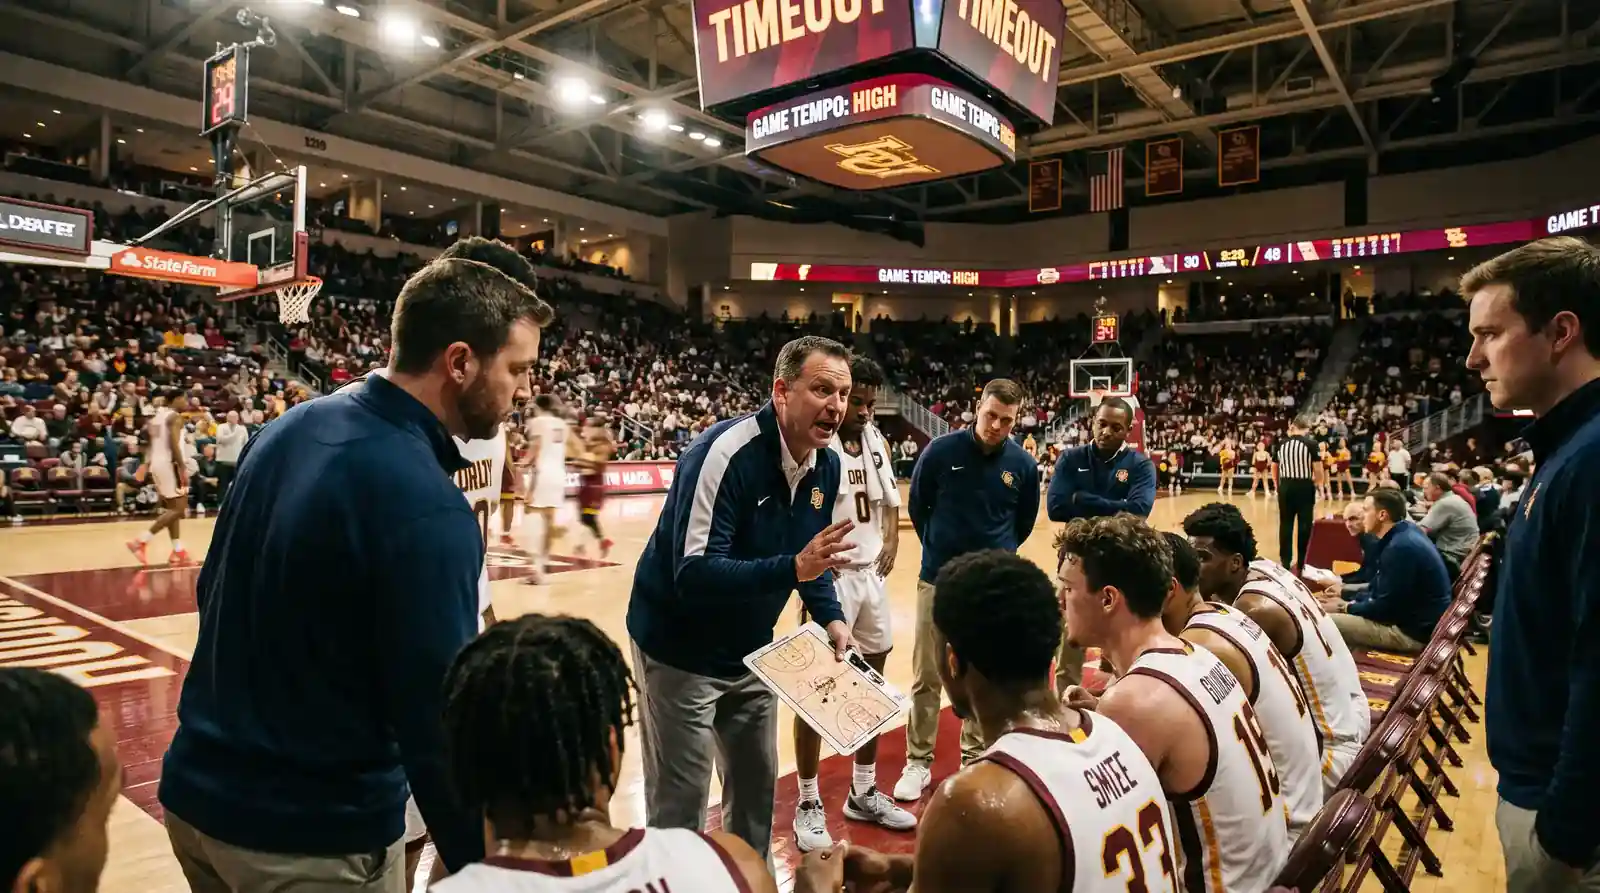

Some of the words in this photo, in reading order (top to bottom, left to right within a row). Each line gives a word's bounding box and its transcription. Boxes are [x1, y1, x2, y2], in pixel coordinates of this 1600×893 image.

[709, 0, 884, 62] TIMEO
[752, 112, 790, 140] GAME
[792, 95, 850, 128] TEMPO:
[853, 84, 897, 114] HIGH
[931, 88, 967, 121] GAME
[967, 103, 1000, 140] TEMPO:
[1547, 208, 1588, 233] GAME
[878, 269, 909, 283] GAME
[911, 270, 951, 285] TEMPO:
[952, 271, 979, 285] HIGH
[1183, 255, 1200, 268] 30
[855, 491, 871, 523] 0
